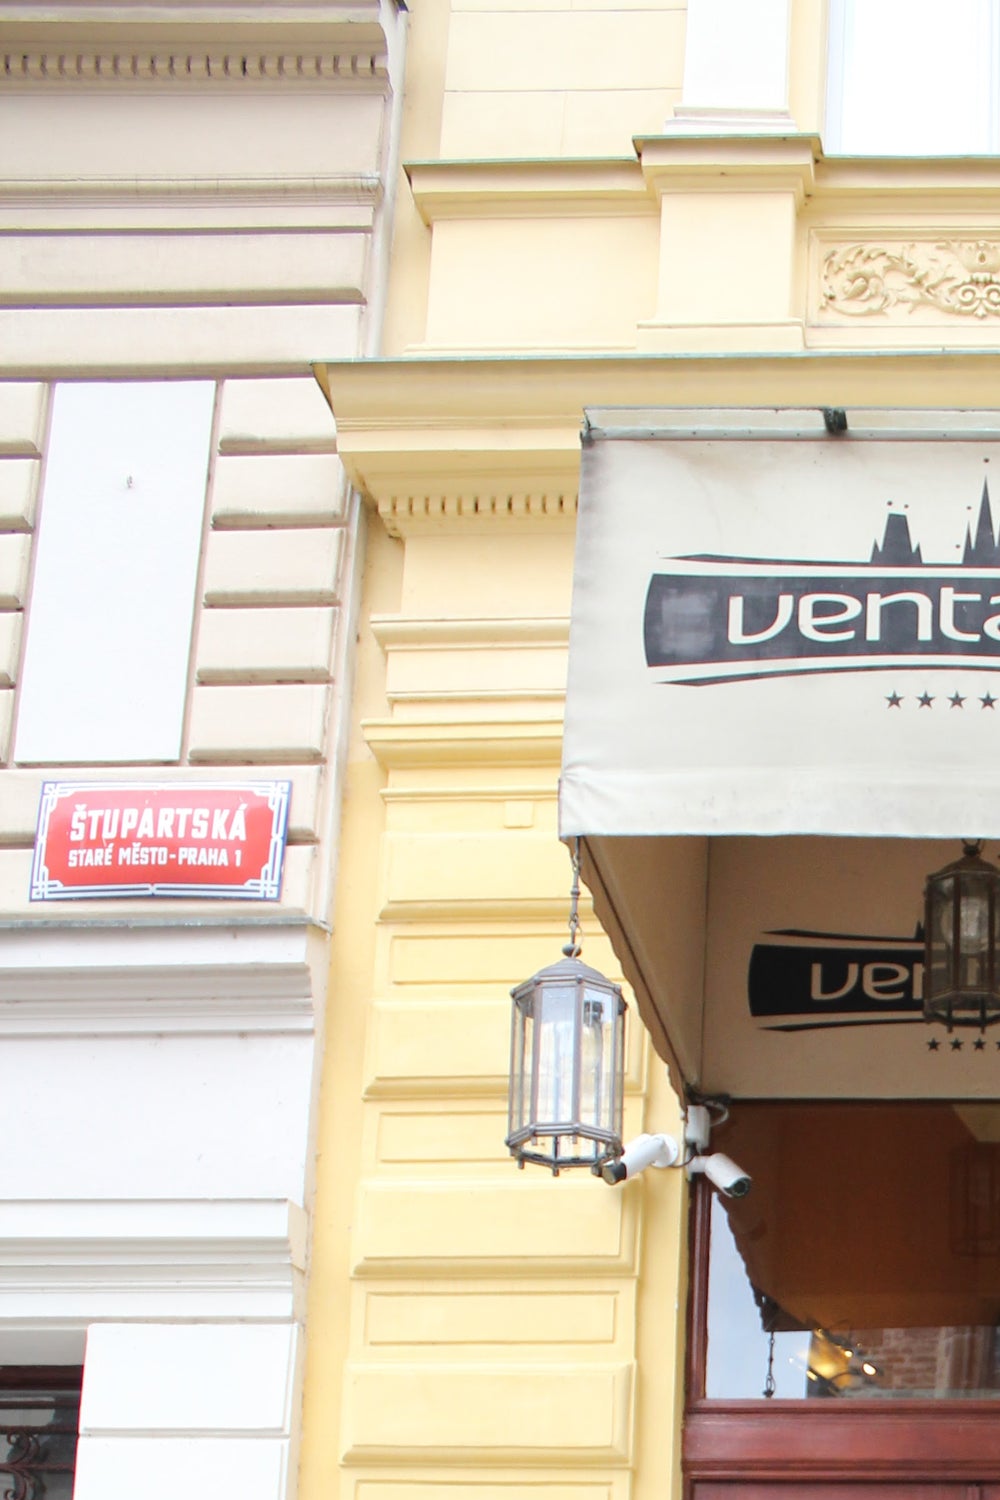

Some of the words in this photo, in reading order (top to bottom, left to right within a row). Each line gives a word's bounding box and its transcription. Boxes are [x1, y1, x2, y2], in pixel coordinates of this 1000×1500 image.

[70, 803, 247, 842] ŠTUPARTSKÁ
[68, 843, 112, 867] STARÉ
[235, 849, 241, 867] 1
